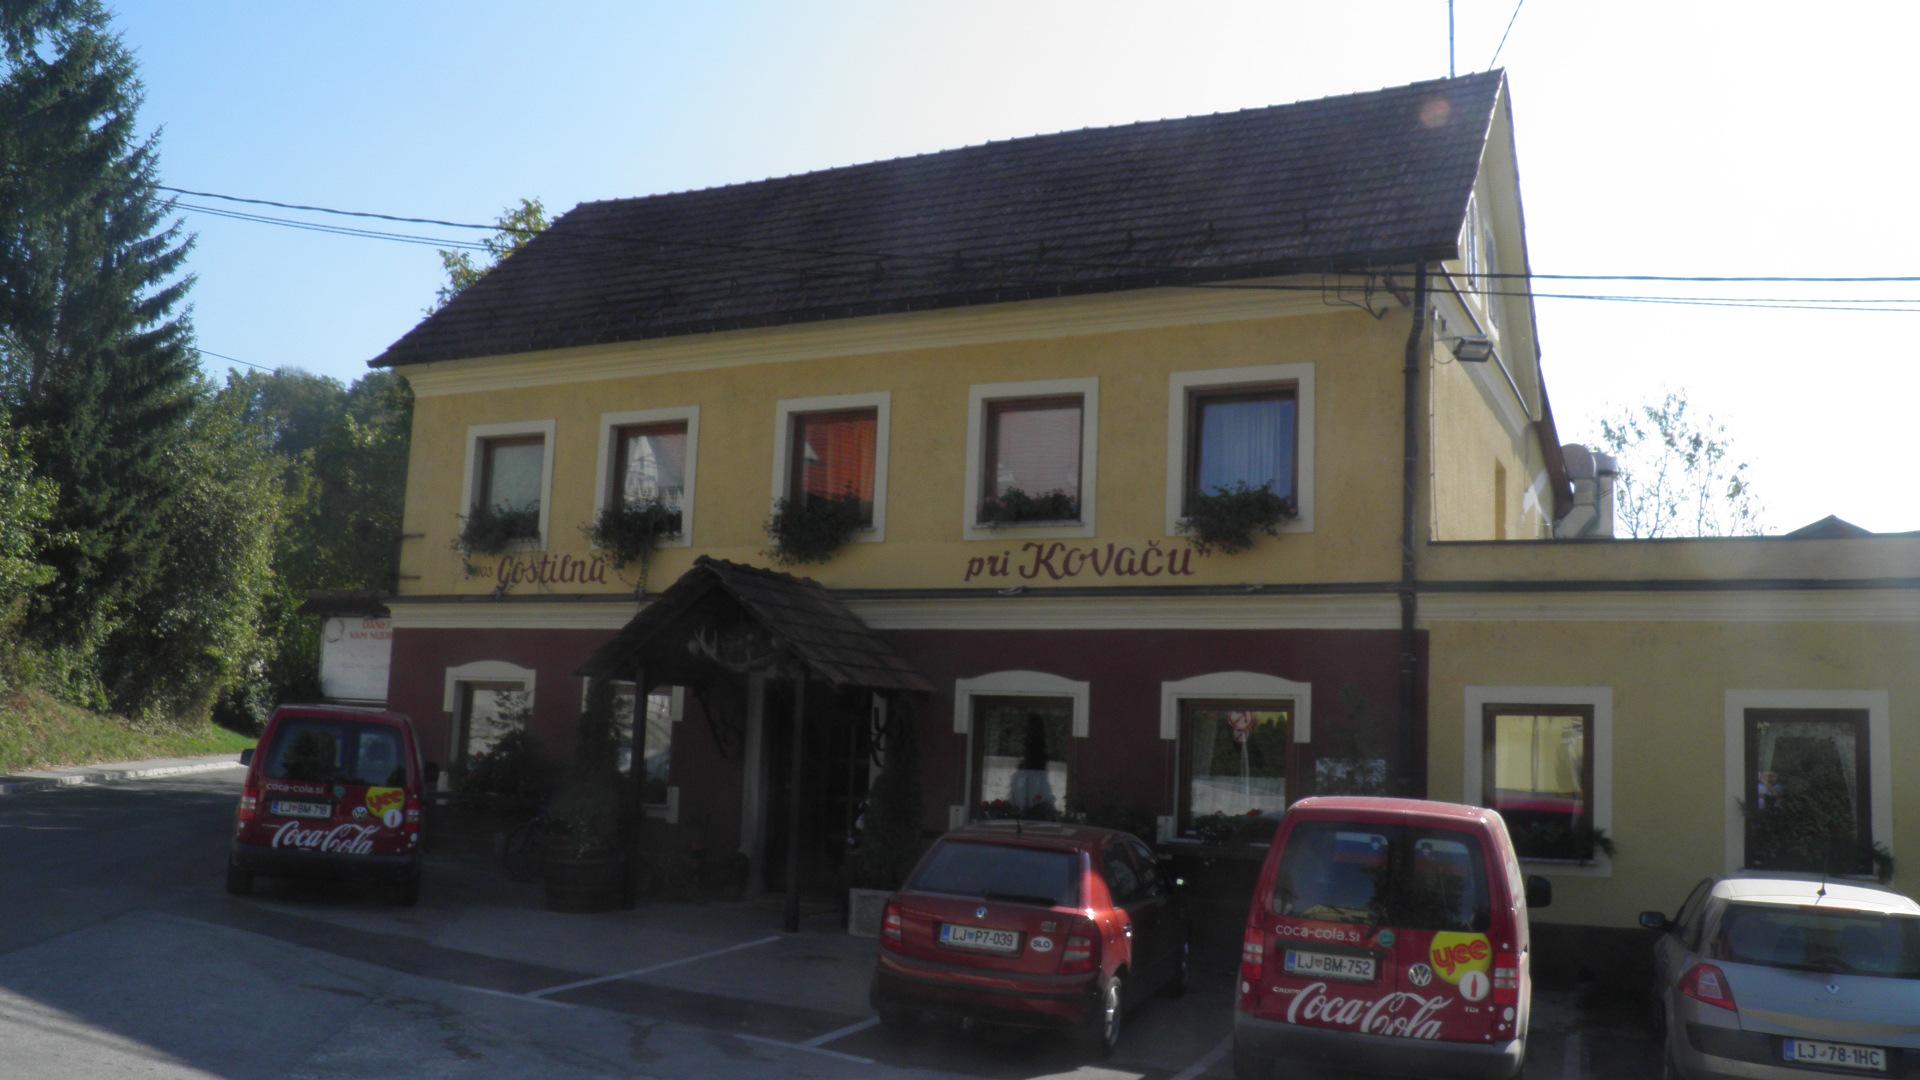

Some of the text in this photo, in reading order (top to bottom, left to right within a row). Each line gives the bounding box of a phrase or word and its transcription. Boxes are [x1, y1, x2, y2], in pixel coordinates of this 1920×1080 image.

[496, 553, 607, 591] Gostilna
[964, 551, 1010, 582] pri
[266, 782, 324, 794] coca-cola.si
[367, 789, 404, 813] yee
[271, 820, 381, 855] Coca-Cola
[974, 931, 1014, 947] P7-039
[1032, 940, 1051, 949] SLO
[1275, 923, 1361, 943] coca-cola.si
[1296, 953, 1372, 976] LJ BM-752
[1432, 939, 1489, 976] yee
[1287, 982, 1455, 1040] Coca-Cola
[1797, 1043, 1881, 1067] LJ 78-1HC
